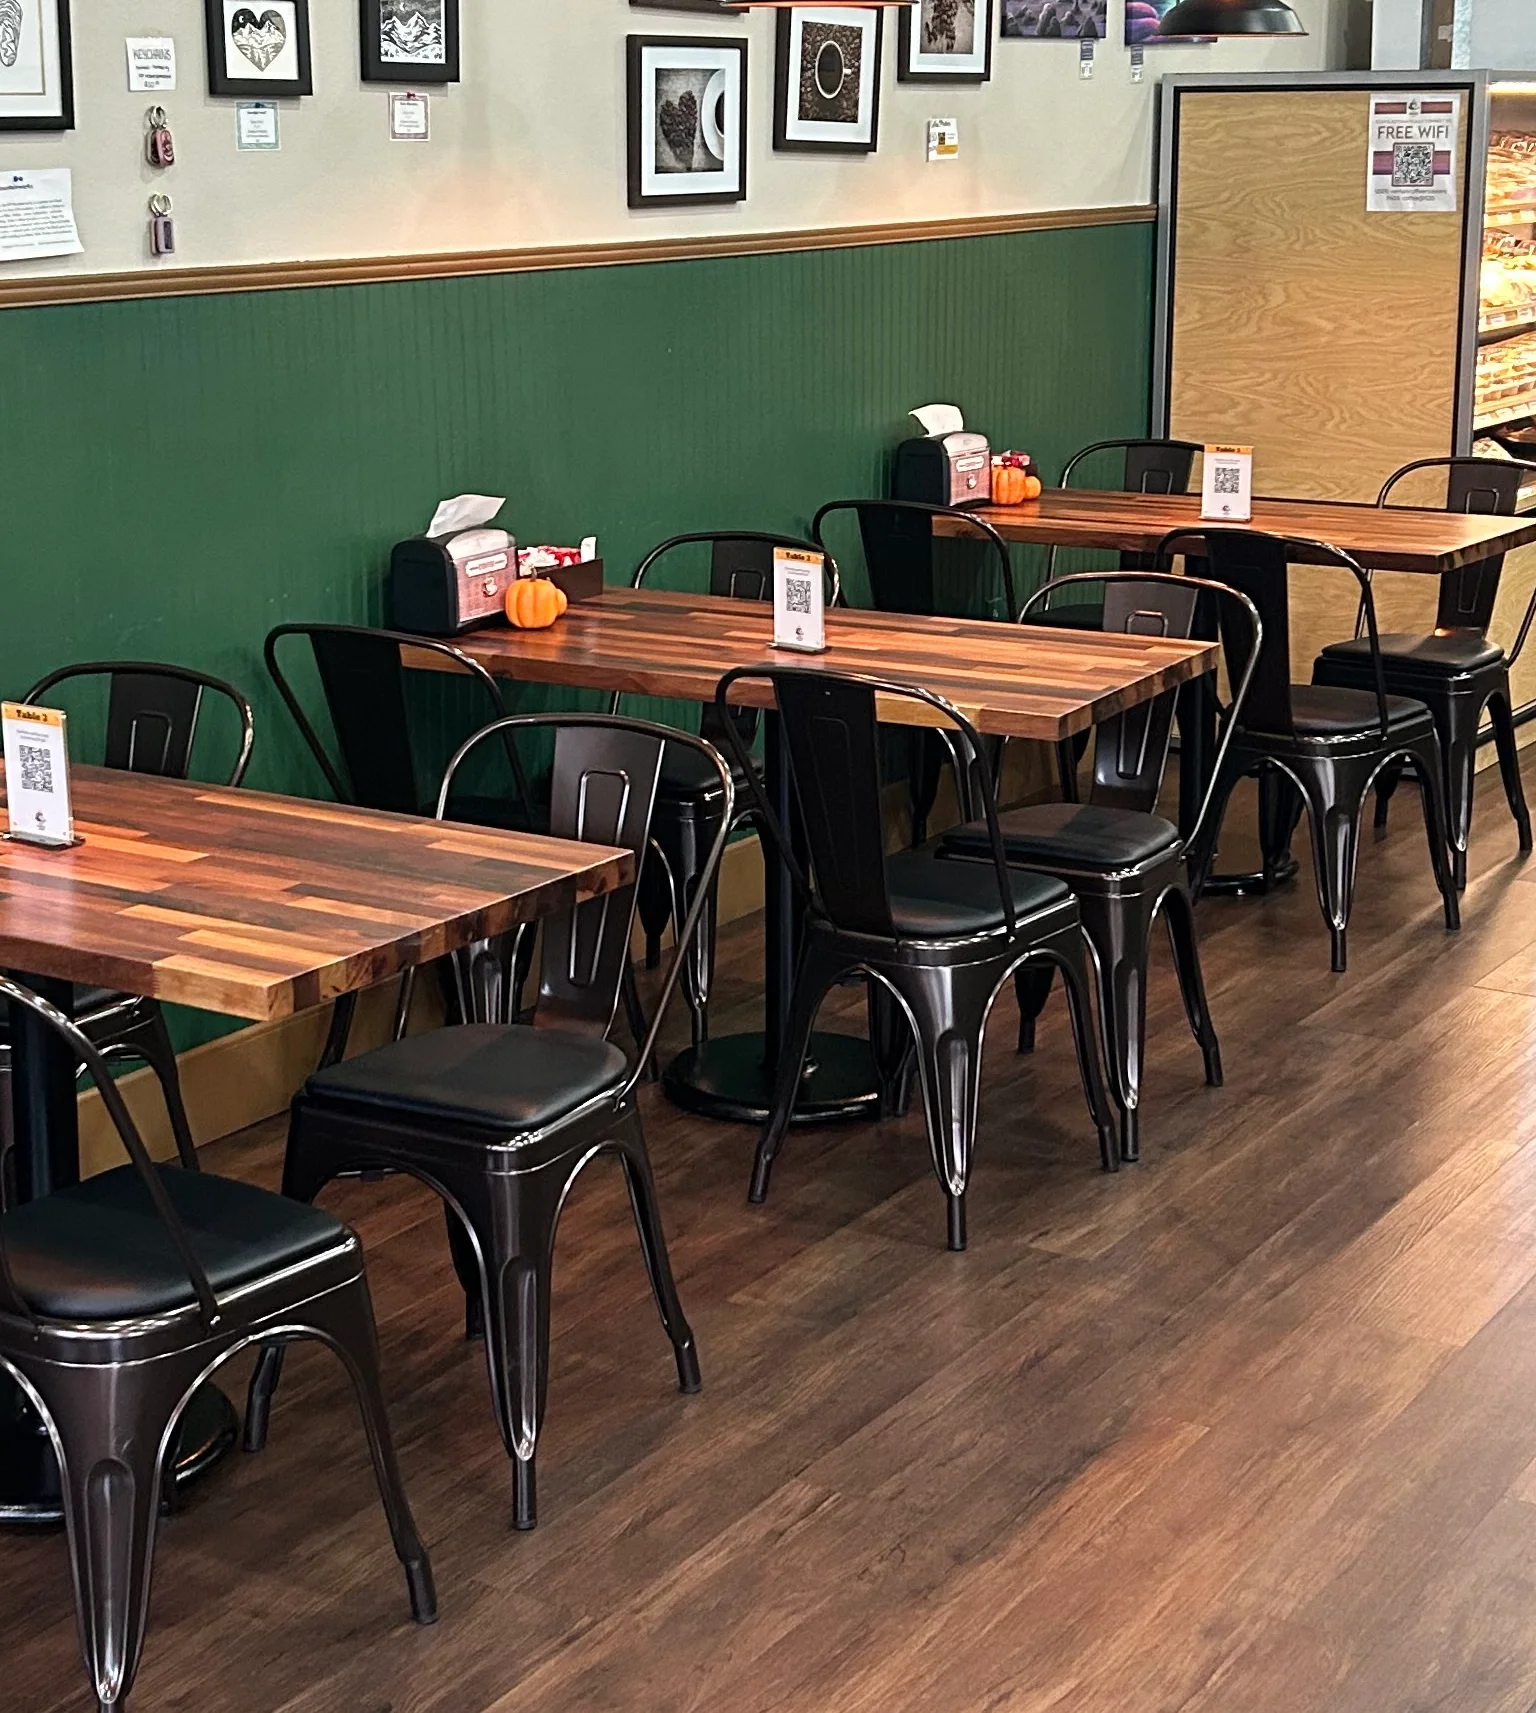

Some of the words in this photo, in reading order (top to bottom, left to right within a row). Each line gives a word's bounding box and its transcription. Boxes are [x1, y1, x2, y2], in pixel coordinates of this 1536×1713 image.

[1377, 125, 1414, 139] FREE
[1418, 125, 1449, 139] WIFI
[786, 552, 805, 560] Table
[16, 709, 41, 721] Table
